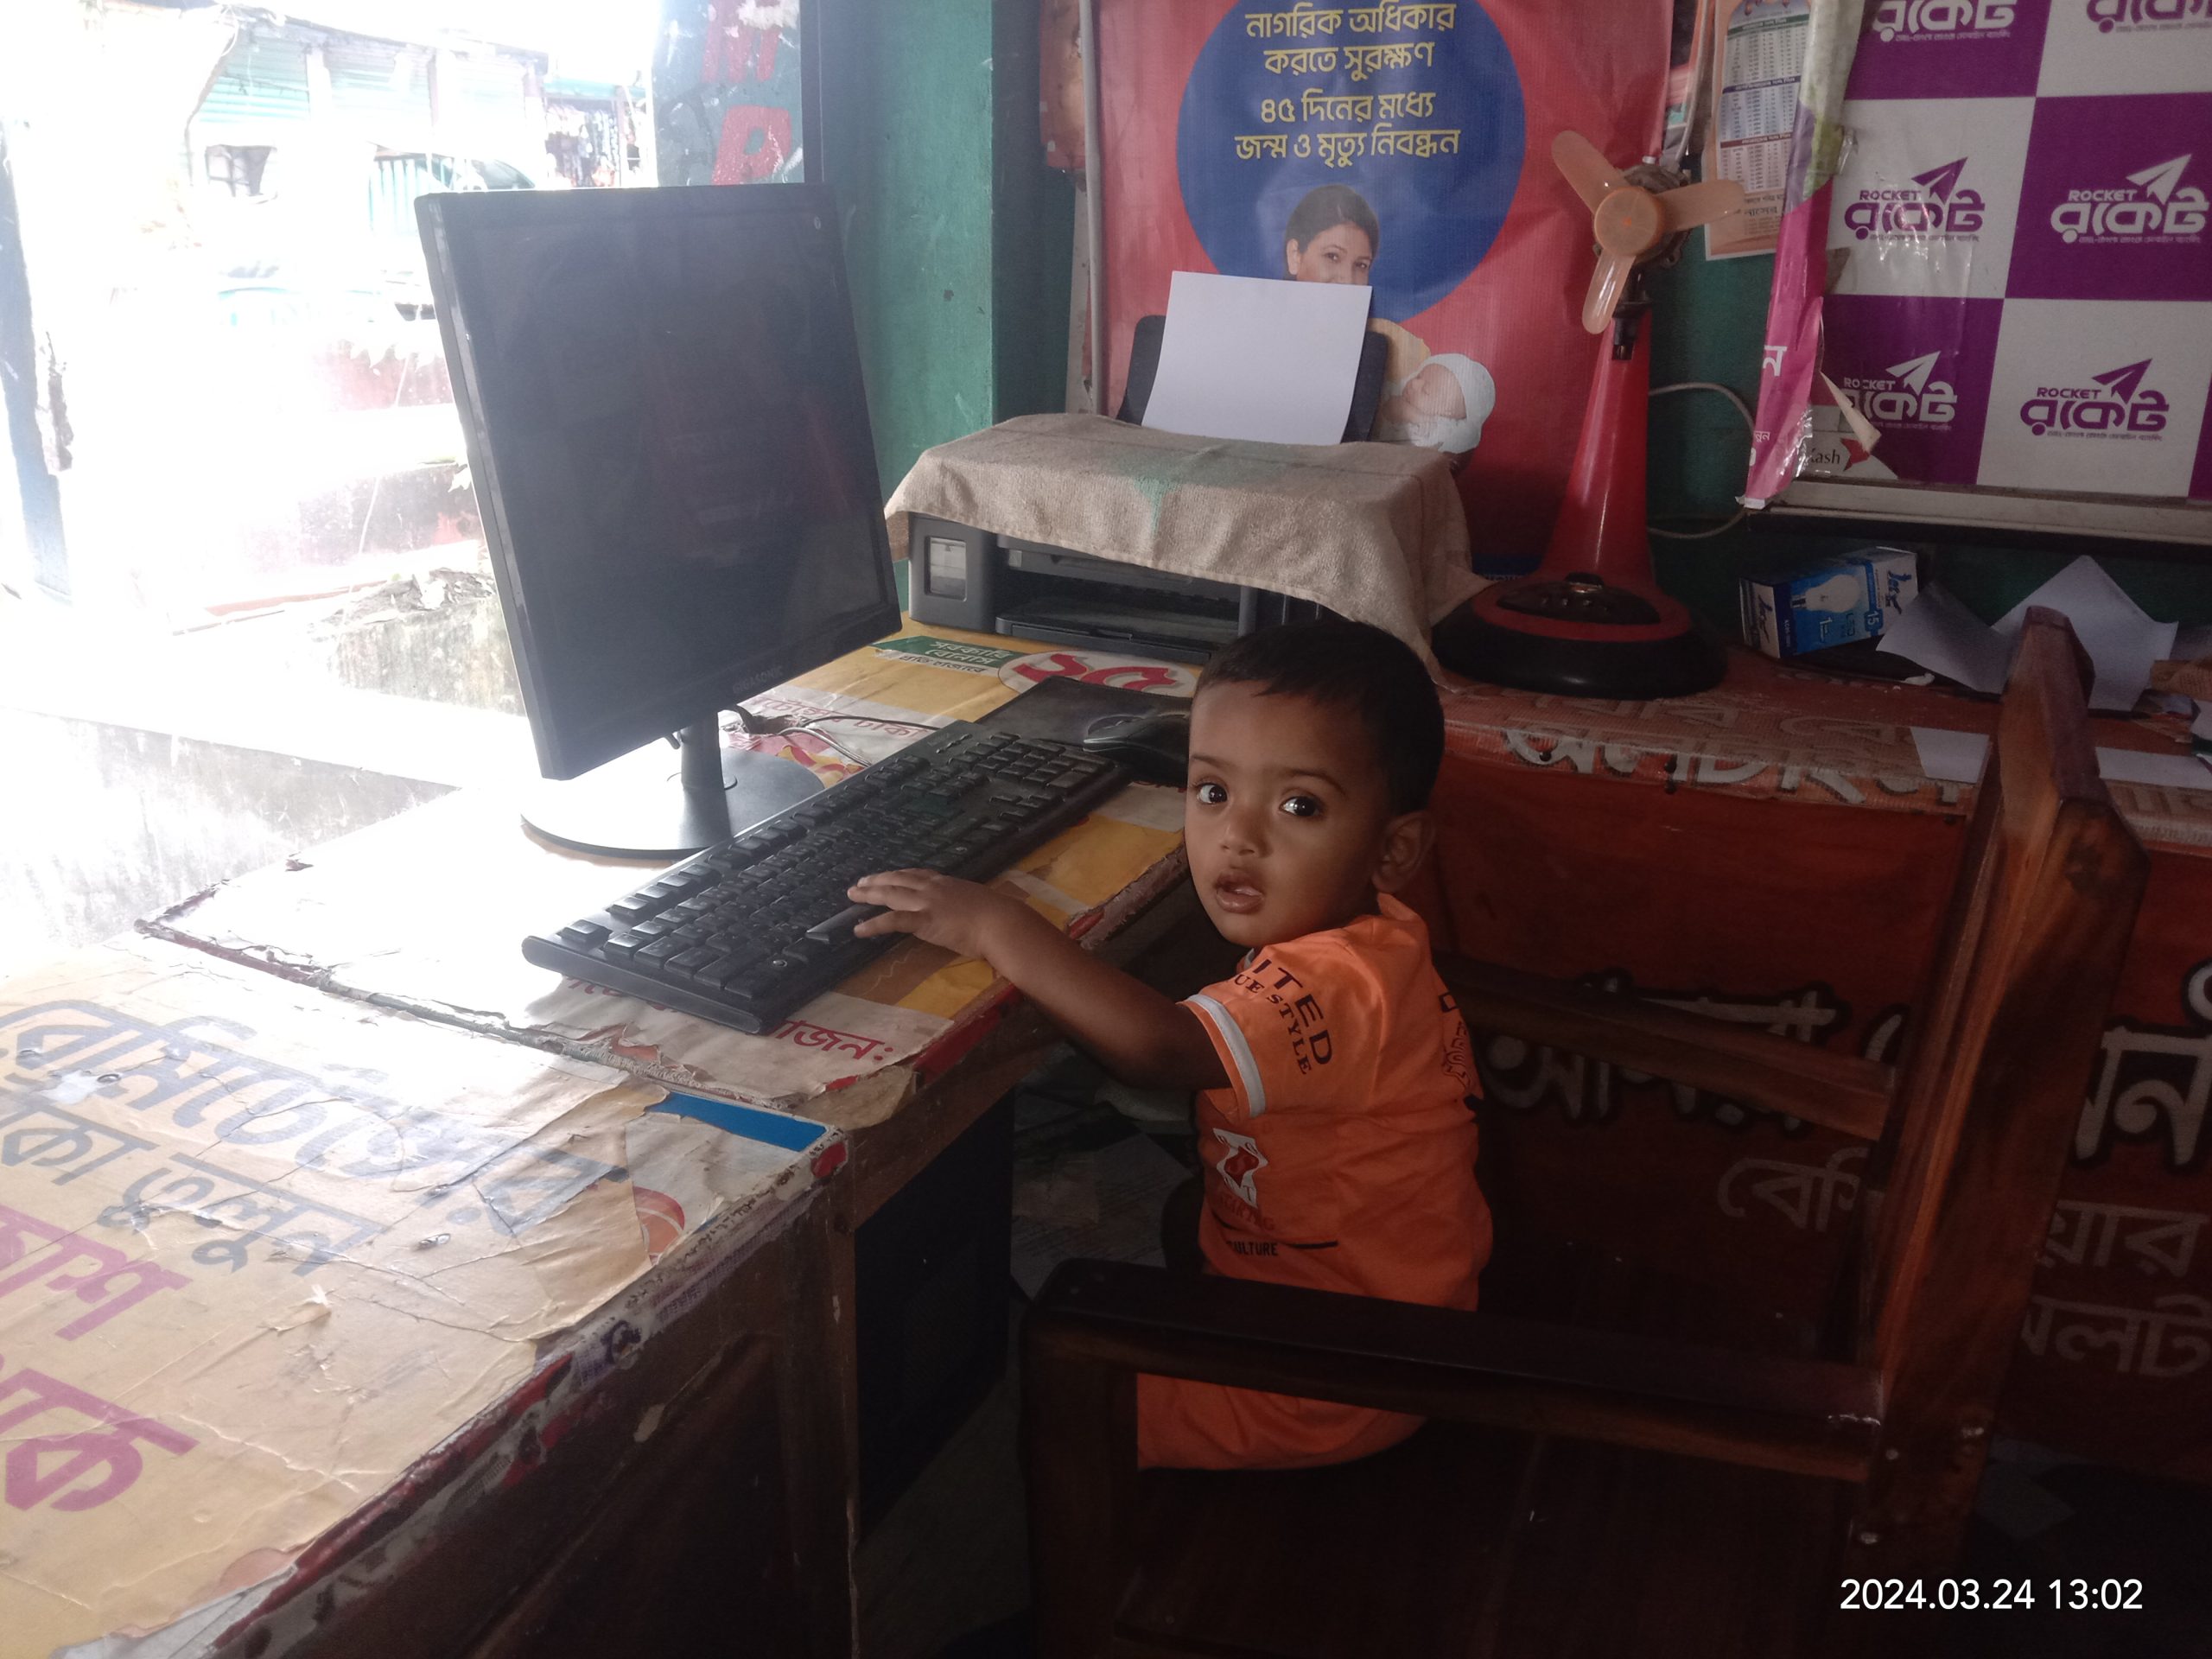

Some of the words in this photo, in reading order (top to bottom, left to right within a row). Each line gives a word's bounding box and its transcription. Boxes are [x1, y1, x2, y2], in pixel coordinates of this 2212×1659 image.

[1246, 2, 1343, 37] নাগরিক
[1349, 0, 1457, 35] অধিকার
[1264, 47, 1337, 74] করতে
[1344, 41, 1434, 81] সুরক্ষণ
[1261, 97, 1295, 124] ৪৫
[1302, 88, 1372, 123] দিনের
[1378, 91, 1436, 120] মধ্যে
[1235, 135, 1287, 160] জন্ম
[1294, 134, 1311, 158] ও
[1318, 130, 1369, 168] মৃত্যু
[1372, 122, 1461, 157] নিবন্ধন
[1844, 188, 1986, 241] রকেট
[1859, 190, 1922, 201] ROCKET
[2050, 186, 2210, 243] রকেট
[2069, 189, 2137, 201] ROCKET
[2020, 390, 2170, 436] রকেট
[2037, 387, 2102, 400] ROCKET
[1235, 974, 1266, 995] UE
[1266, 994, 1313, 1075] STYLE
[1252, 958, 1334, 1065] ITED
